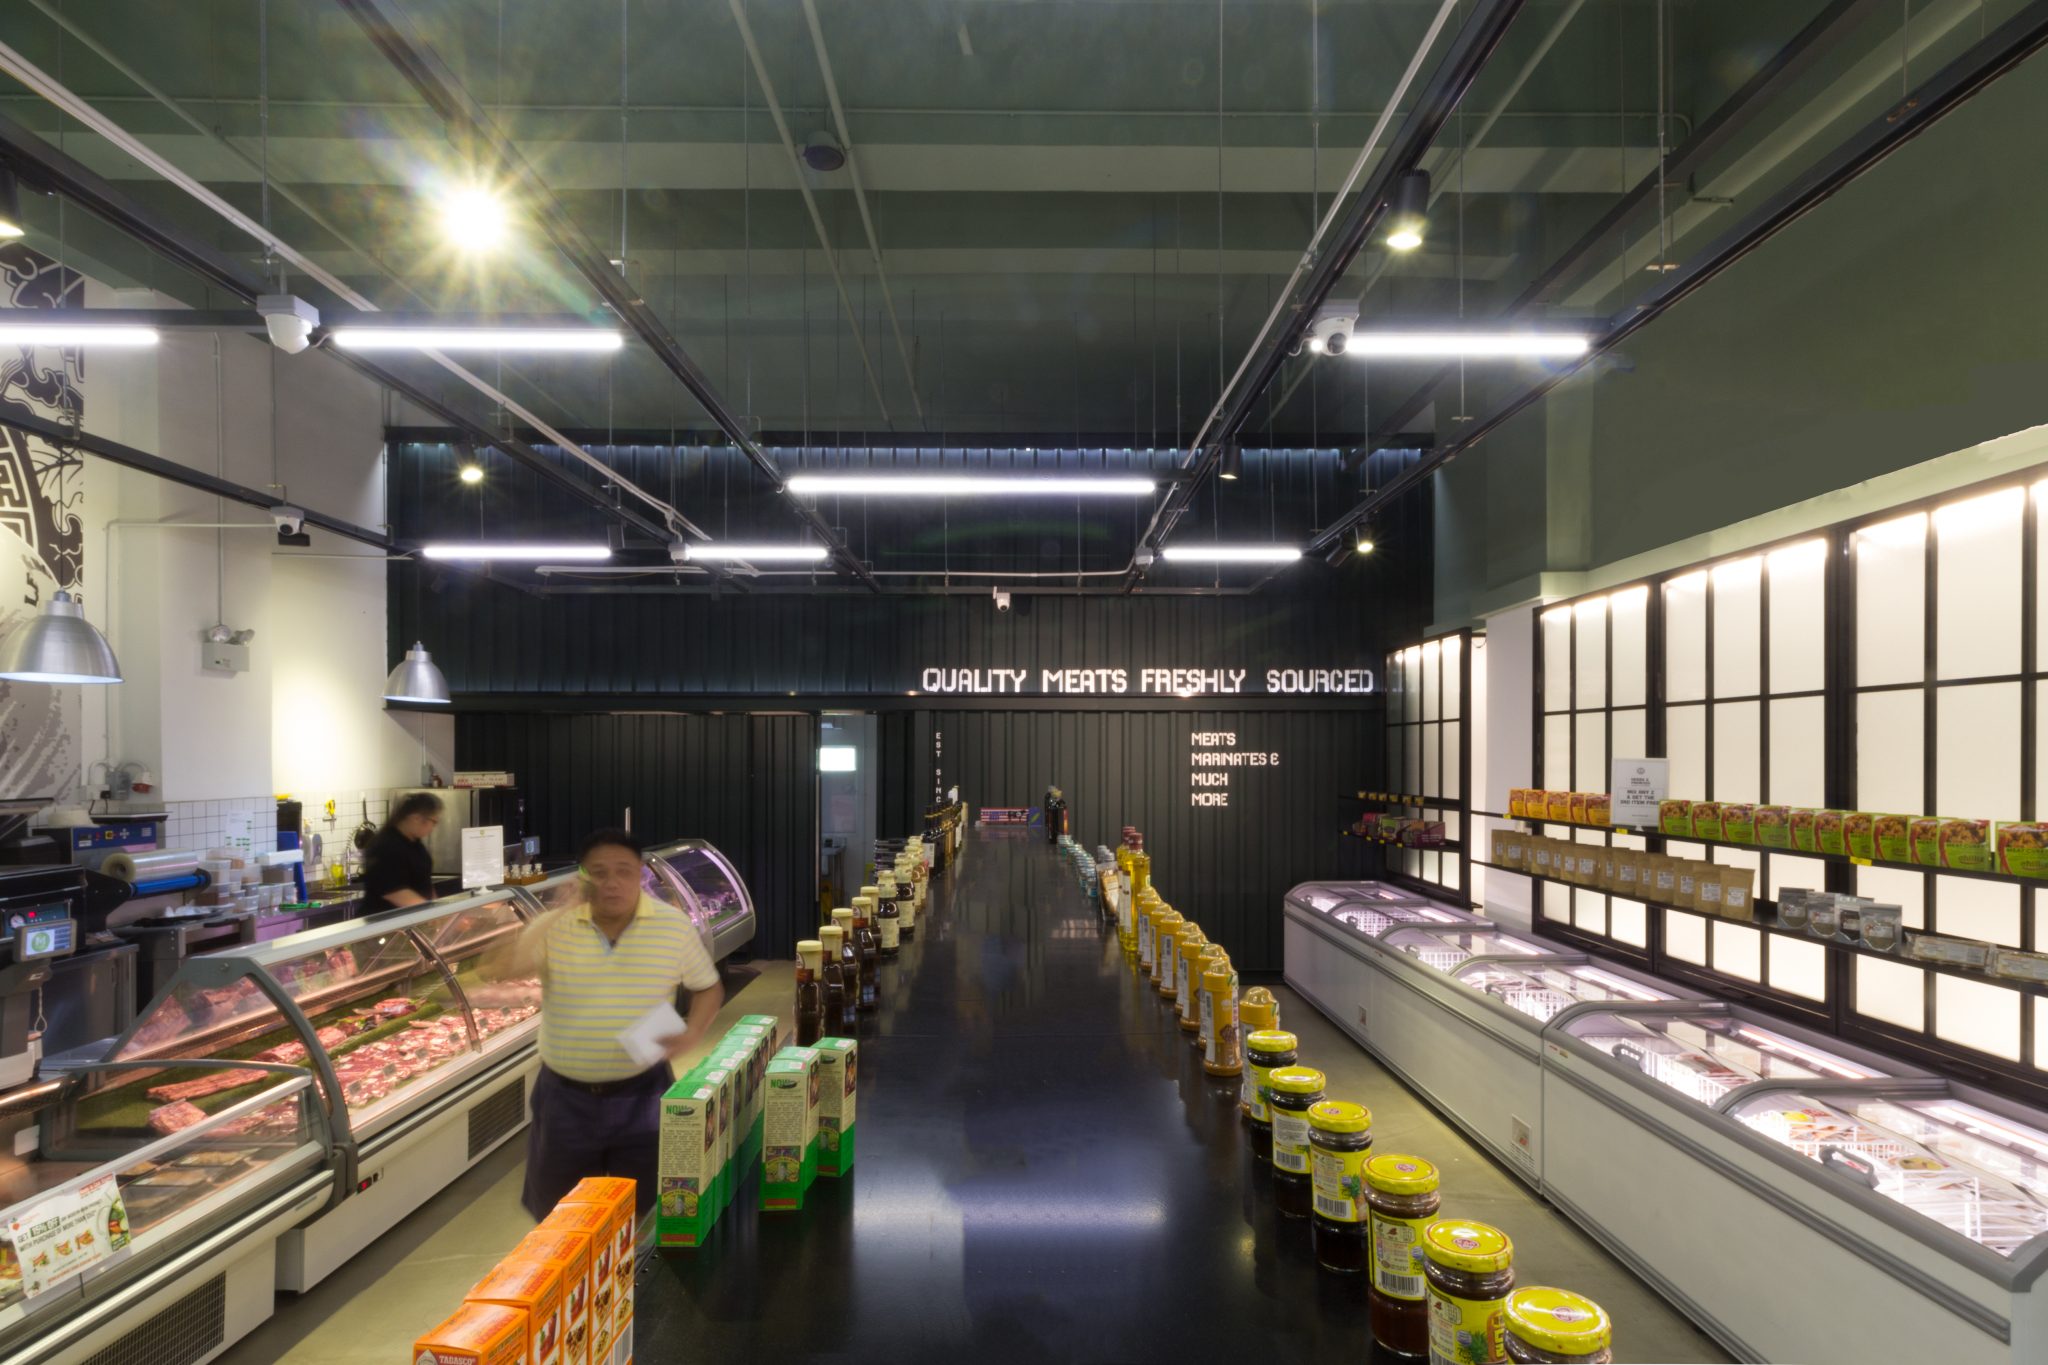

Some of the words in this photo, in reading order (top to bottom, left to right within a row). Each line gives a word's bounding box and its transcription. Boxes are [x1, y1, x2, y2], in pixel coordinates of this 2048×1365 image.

[922, 667, 1027, 693] QUALITY
[1042, 668, 1128, 693] MEATS
[1141, 668, 1246, 693] FRESHLY
[1266, 669, 1374, 693] SOURCED
[1191, 732, 1236, 746] MEATS
[1191, 752, 1267, 766] MARINATES
[1191, 772, 1228, 786] MUCH
[1191, 792, 1228, 806] MORE
